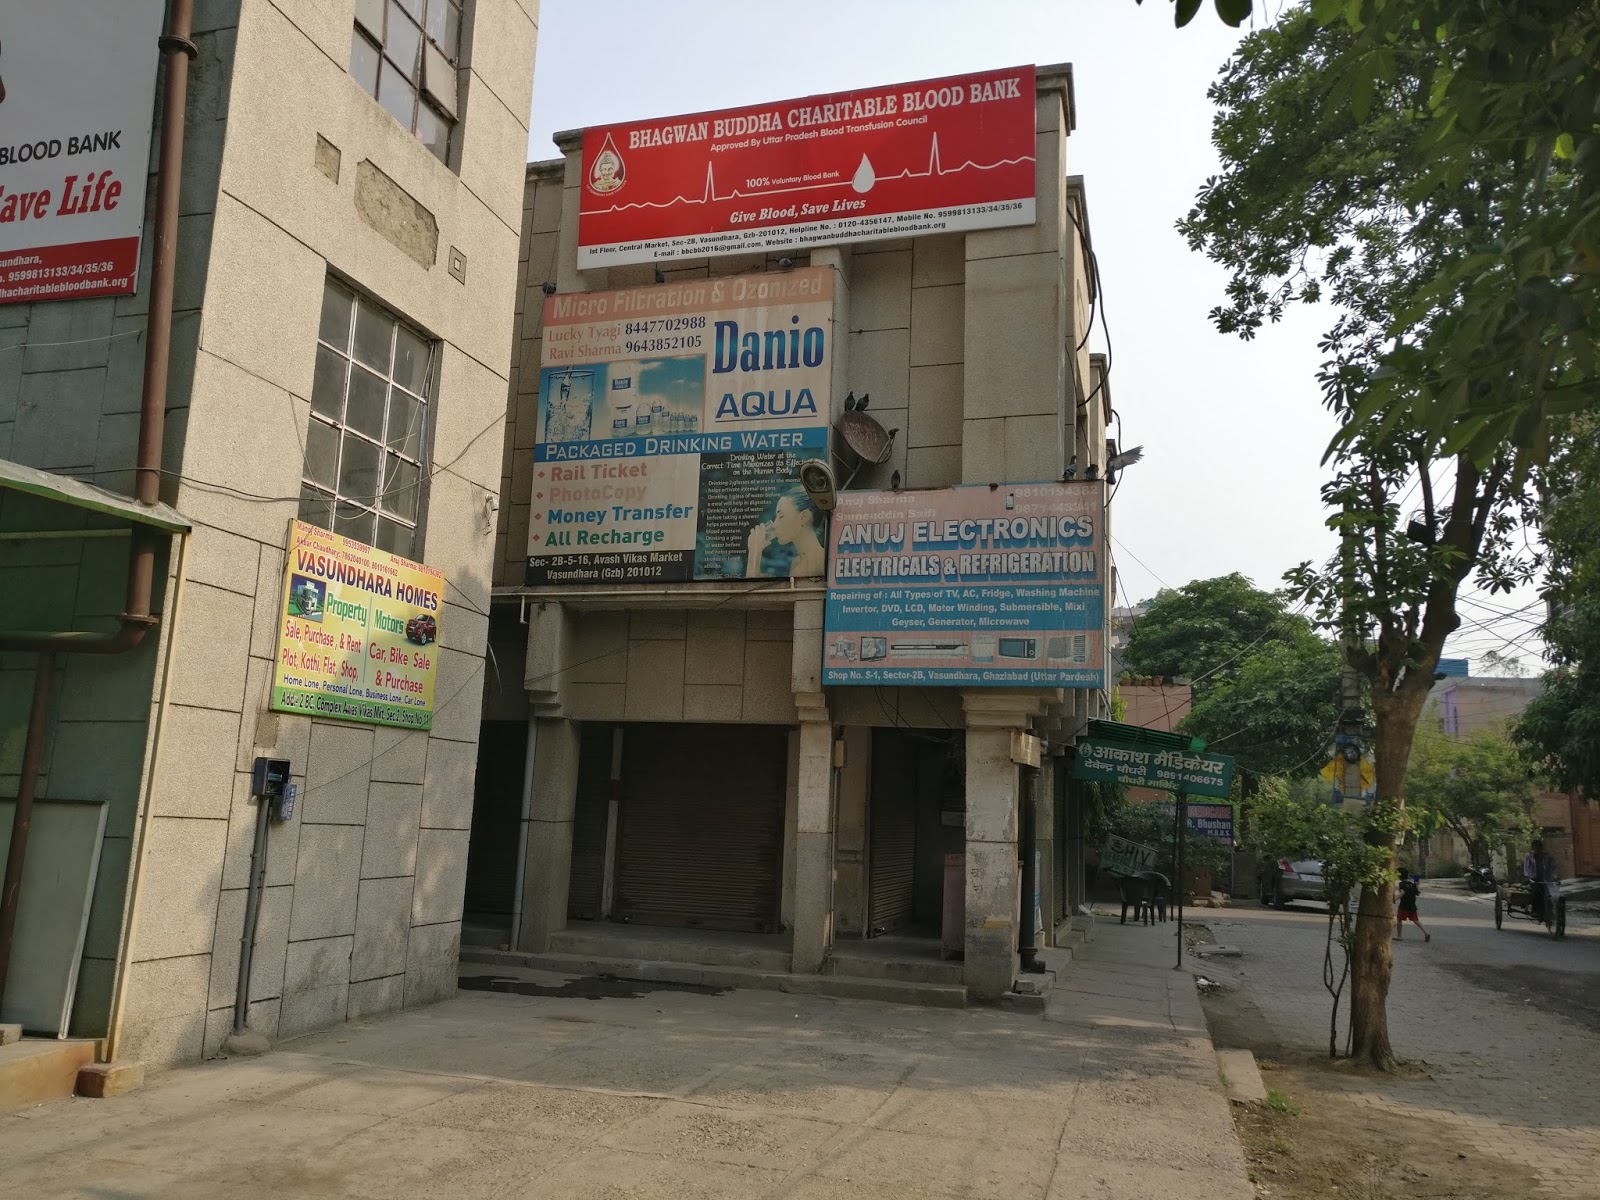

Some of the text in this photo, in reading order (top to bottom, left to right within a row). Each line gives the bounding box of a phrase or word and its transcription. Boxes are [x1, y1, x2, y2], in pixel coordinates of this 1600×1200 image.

[629, 77, 1021, 149] BHAGWAN BUDDHA CHARITABLE BLOOD BANK
[67, 130, 122, 156] BANK
[710, 115, 928, 152] Approved By Uttar Pradesh Blood Transfusion Council
[746, 170, 840, 188] 100% Voluntary Blood Bank
[56, 170, 122, 216] Life
[730, 198, 866, 224] Give Blood, Save Lives
[619, 243, 642, 252] Central
[644, 241, 670, 249] Market,
[700, 230, 741, 243] Vasundhara,
[789, 224, 818, 236] Helpline
[896, 212, 922, 223] Mobile
[8, 261, 114, 282] 9599813133/34/35/36
[553, 296, 608, 319] Micro
[613, 284, 705, 312] Filtration
[711, 280, 726, 304] &
[549, 316, 706, 343] Lucky Tyagi 8447702988
[549, 335, 702, 360] Ravi Sharma 9643852105
[712, 315, 825, 374] Danio
[715, 388, 817, 419] AQUA
[545, 432, 803, 461] PACKAGED DRINKING WATER
[551, 462, 648, 482] Rail Ticket
[549, 484, 648, 503] PhotoCopy
[547, 504, 694, 525] Money Transfer
[545, 529, 665, 547] All Recharge
[838, 515, 1094, 549] ANUJ ELECTRONICS
[551, 555, 592, 567] 2B-5-16,
[594, 553, 620, 565] Avash
[623, 552, 648, 564] Vikas
[650, 551, 682, 563] Market
[835, 551, 1095, 580] ELECTRICALS & REFRIGERATION
[296, 548, 392, 598] VASUNDHARA
[396, 580, 439, 611] HOMES
[547, 566, 662, 580] Vasundhara (Gzb) 201012
[830, 591, 871, 601] Repairing
[890, 591, 902, 599] All
[904, 590, 932, 601] Types
[933, 589, 943, 598] of
[962, 590, 979, 599] AC,
[981, 589, 1014, 599] Fridge,
[1016, 588, 1057, 599] Washing
[1059, 587, 1100, 597] Machine
[326, 591, 404, 635] Property Motors
[881, 604, 903, 614] DVD,
[905, 604, 926, 613] LCD,
[928, 603, 955, 612] Motor
[957, 603, 997, 613] Winding,
[999, 602, 1062, 612] Submersible,
[891, 617, 1030, 628] Geyser, Generator, Microwave
[285, 620, 302, 643] Sale,
[339, 633, 345, 649] &
[347, 634, 362, 654] Rent
[282, 648, 299, 671] Plot,
[300, 651, 321, 673] Kothi,
[369, 642, 431, 671] Car, Bike Sale
[283, 674, 302, 686] Home
[322, 681, 348, 695] Personal
[366, 688, 388, 701] Business
[404, 695, 414, 705] Car
[375, 669, 424, 694] & Purchase
[828, 671, 848, 681] Shop
[883, 670, 926, 681] Sector-2B,
[928, 671, 981, 681] Vasundhara,
[982, 672, 1029, 681] Ghaziabad
[1031, 672, 1057, 682] (Uttar
[1060, 672, 1100, 683] Pardesh)
[1093, 746, 1226, 774] आकाश मैडिकेयर
[1156, 770, 1224, 787] 9891406675
[1197, 818, 1231, 829] Bhushan
